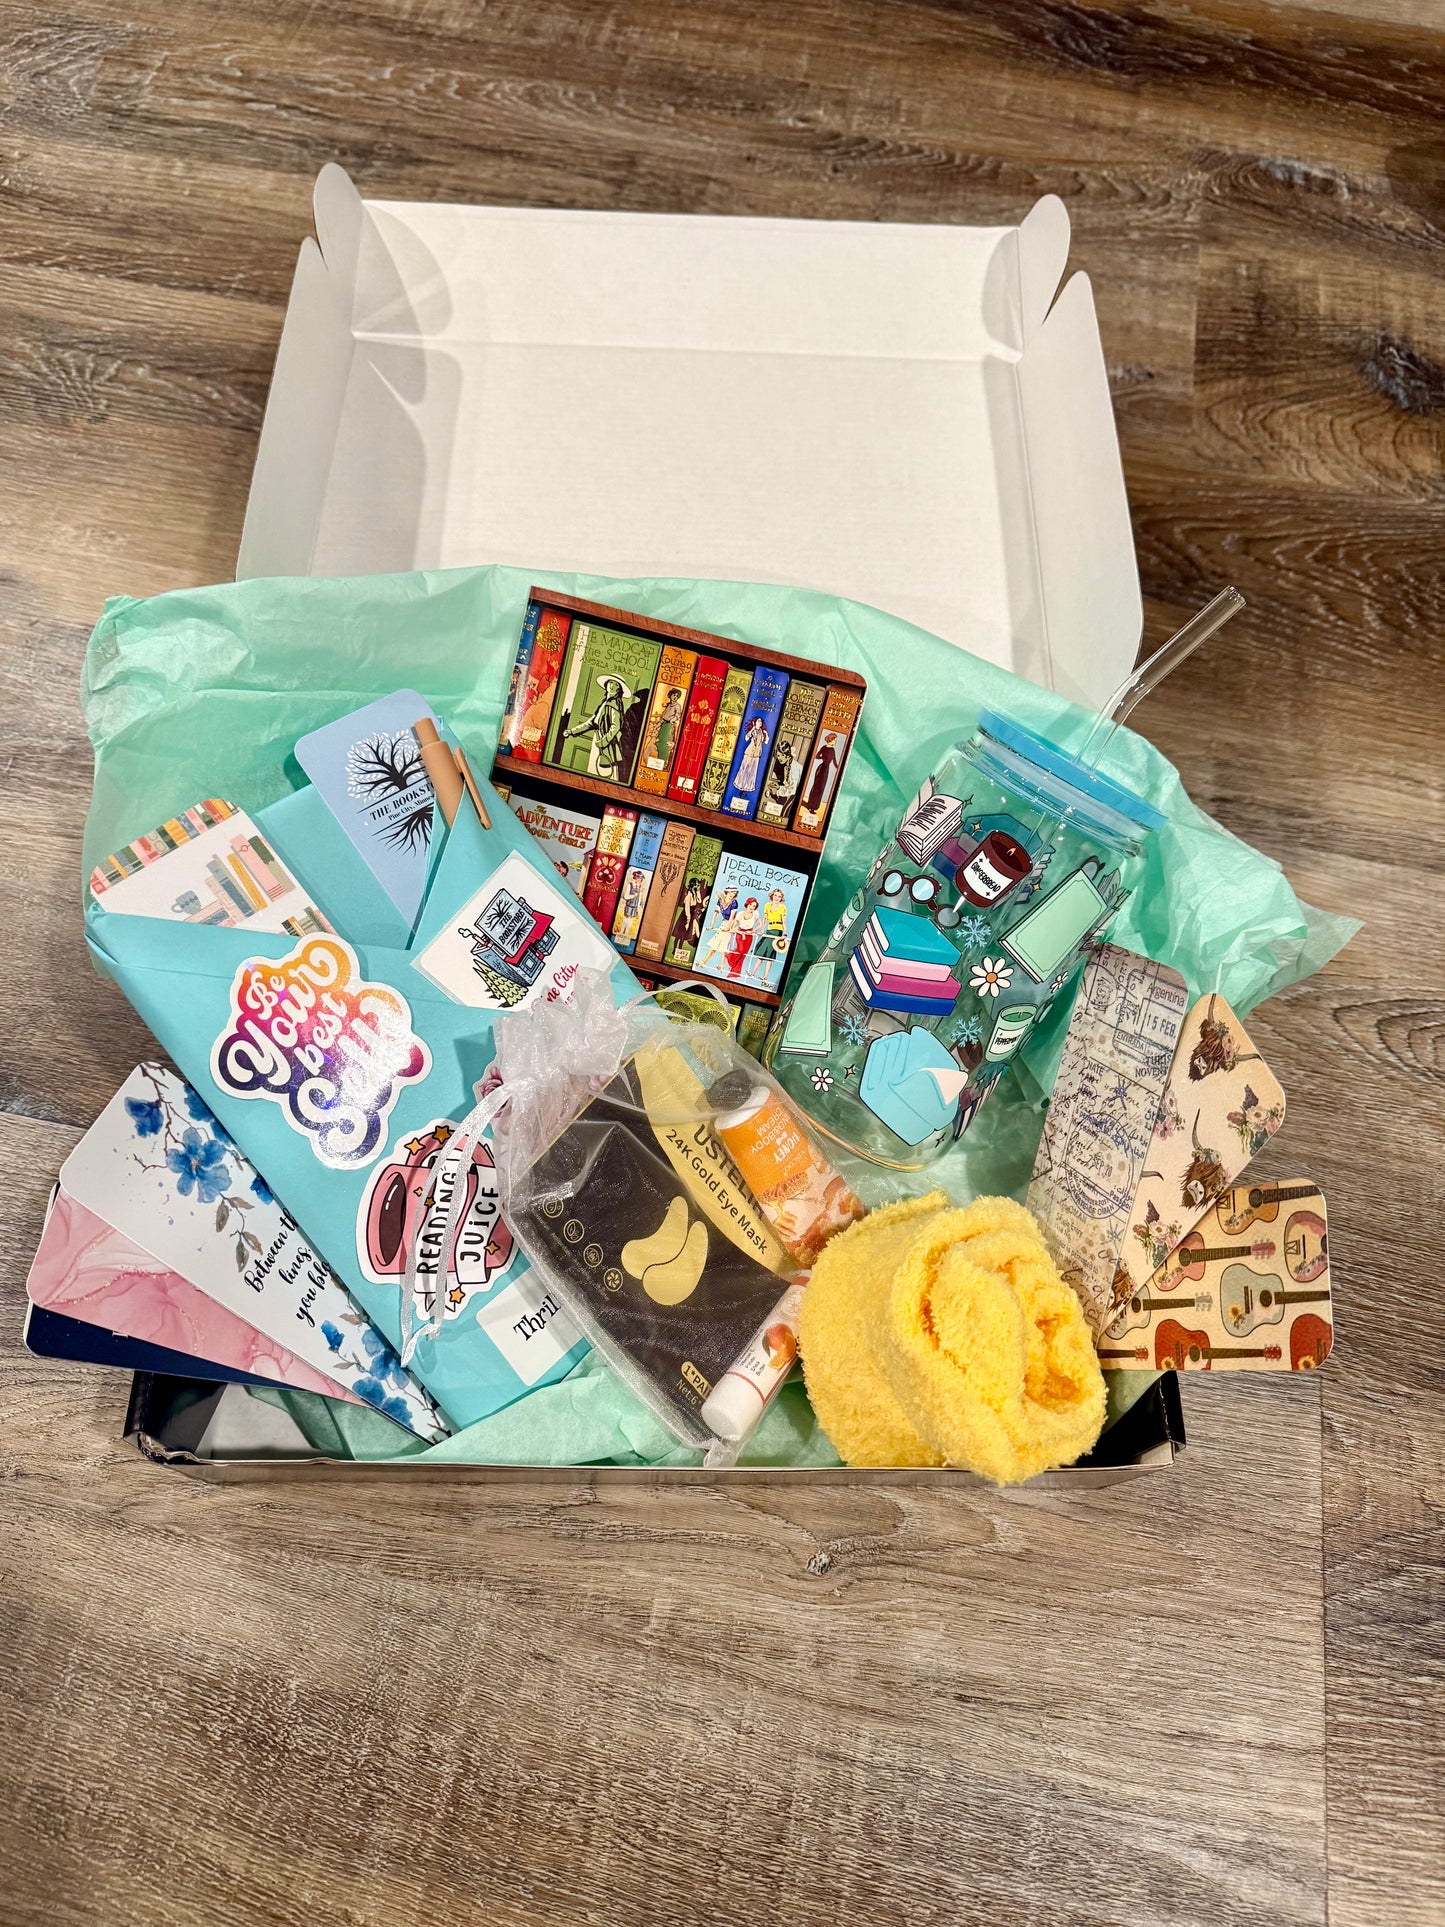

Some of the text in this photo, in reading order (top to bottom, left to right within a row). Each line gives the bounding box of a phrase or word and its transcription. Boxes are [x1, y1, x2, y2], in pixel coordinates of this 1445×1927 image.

[576, 626, 598, 643] THE
[601, 634, 655, 658] MADCAP
[605, 649, 651, 671] SCHOOL
[370, 803, 391, 820] THE
[515, 806, 594, 841] ADVENTURE
[723, 857, 761, 878] IDEAL
[765, 868, 800, 888] BOOK
[738, 875, 771, 892] GIRLS
[499, 908, 525, 945] BOOKSTORE
[500, 911, 513, 927] THE
[553, 963, 579, 989] City
[246, 971, 286, 1020] Be
[1147, 982, 1185, 1008] Argentina
[226, 946, 339, 1087] Your
[756, 1107, 783, 1137] CREAM
[773, 1131, 800, 1164] HONEY
[666, 1129, 768, 1255] 24K Gold Eye Mask
[416, 1172, 457, 1274] READING
[244, 1207, 299, 1293] Between th
[296, 1261, 332, 1328] you blo
[512, 1294, 562, 1341] Thril
